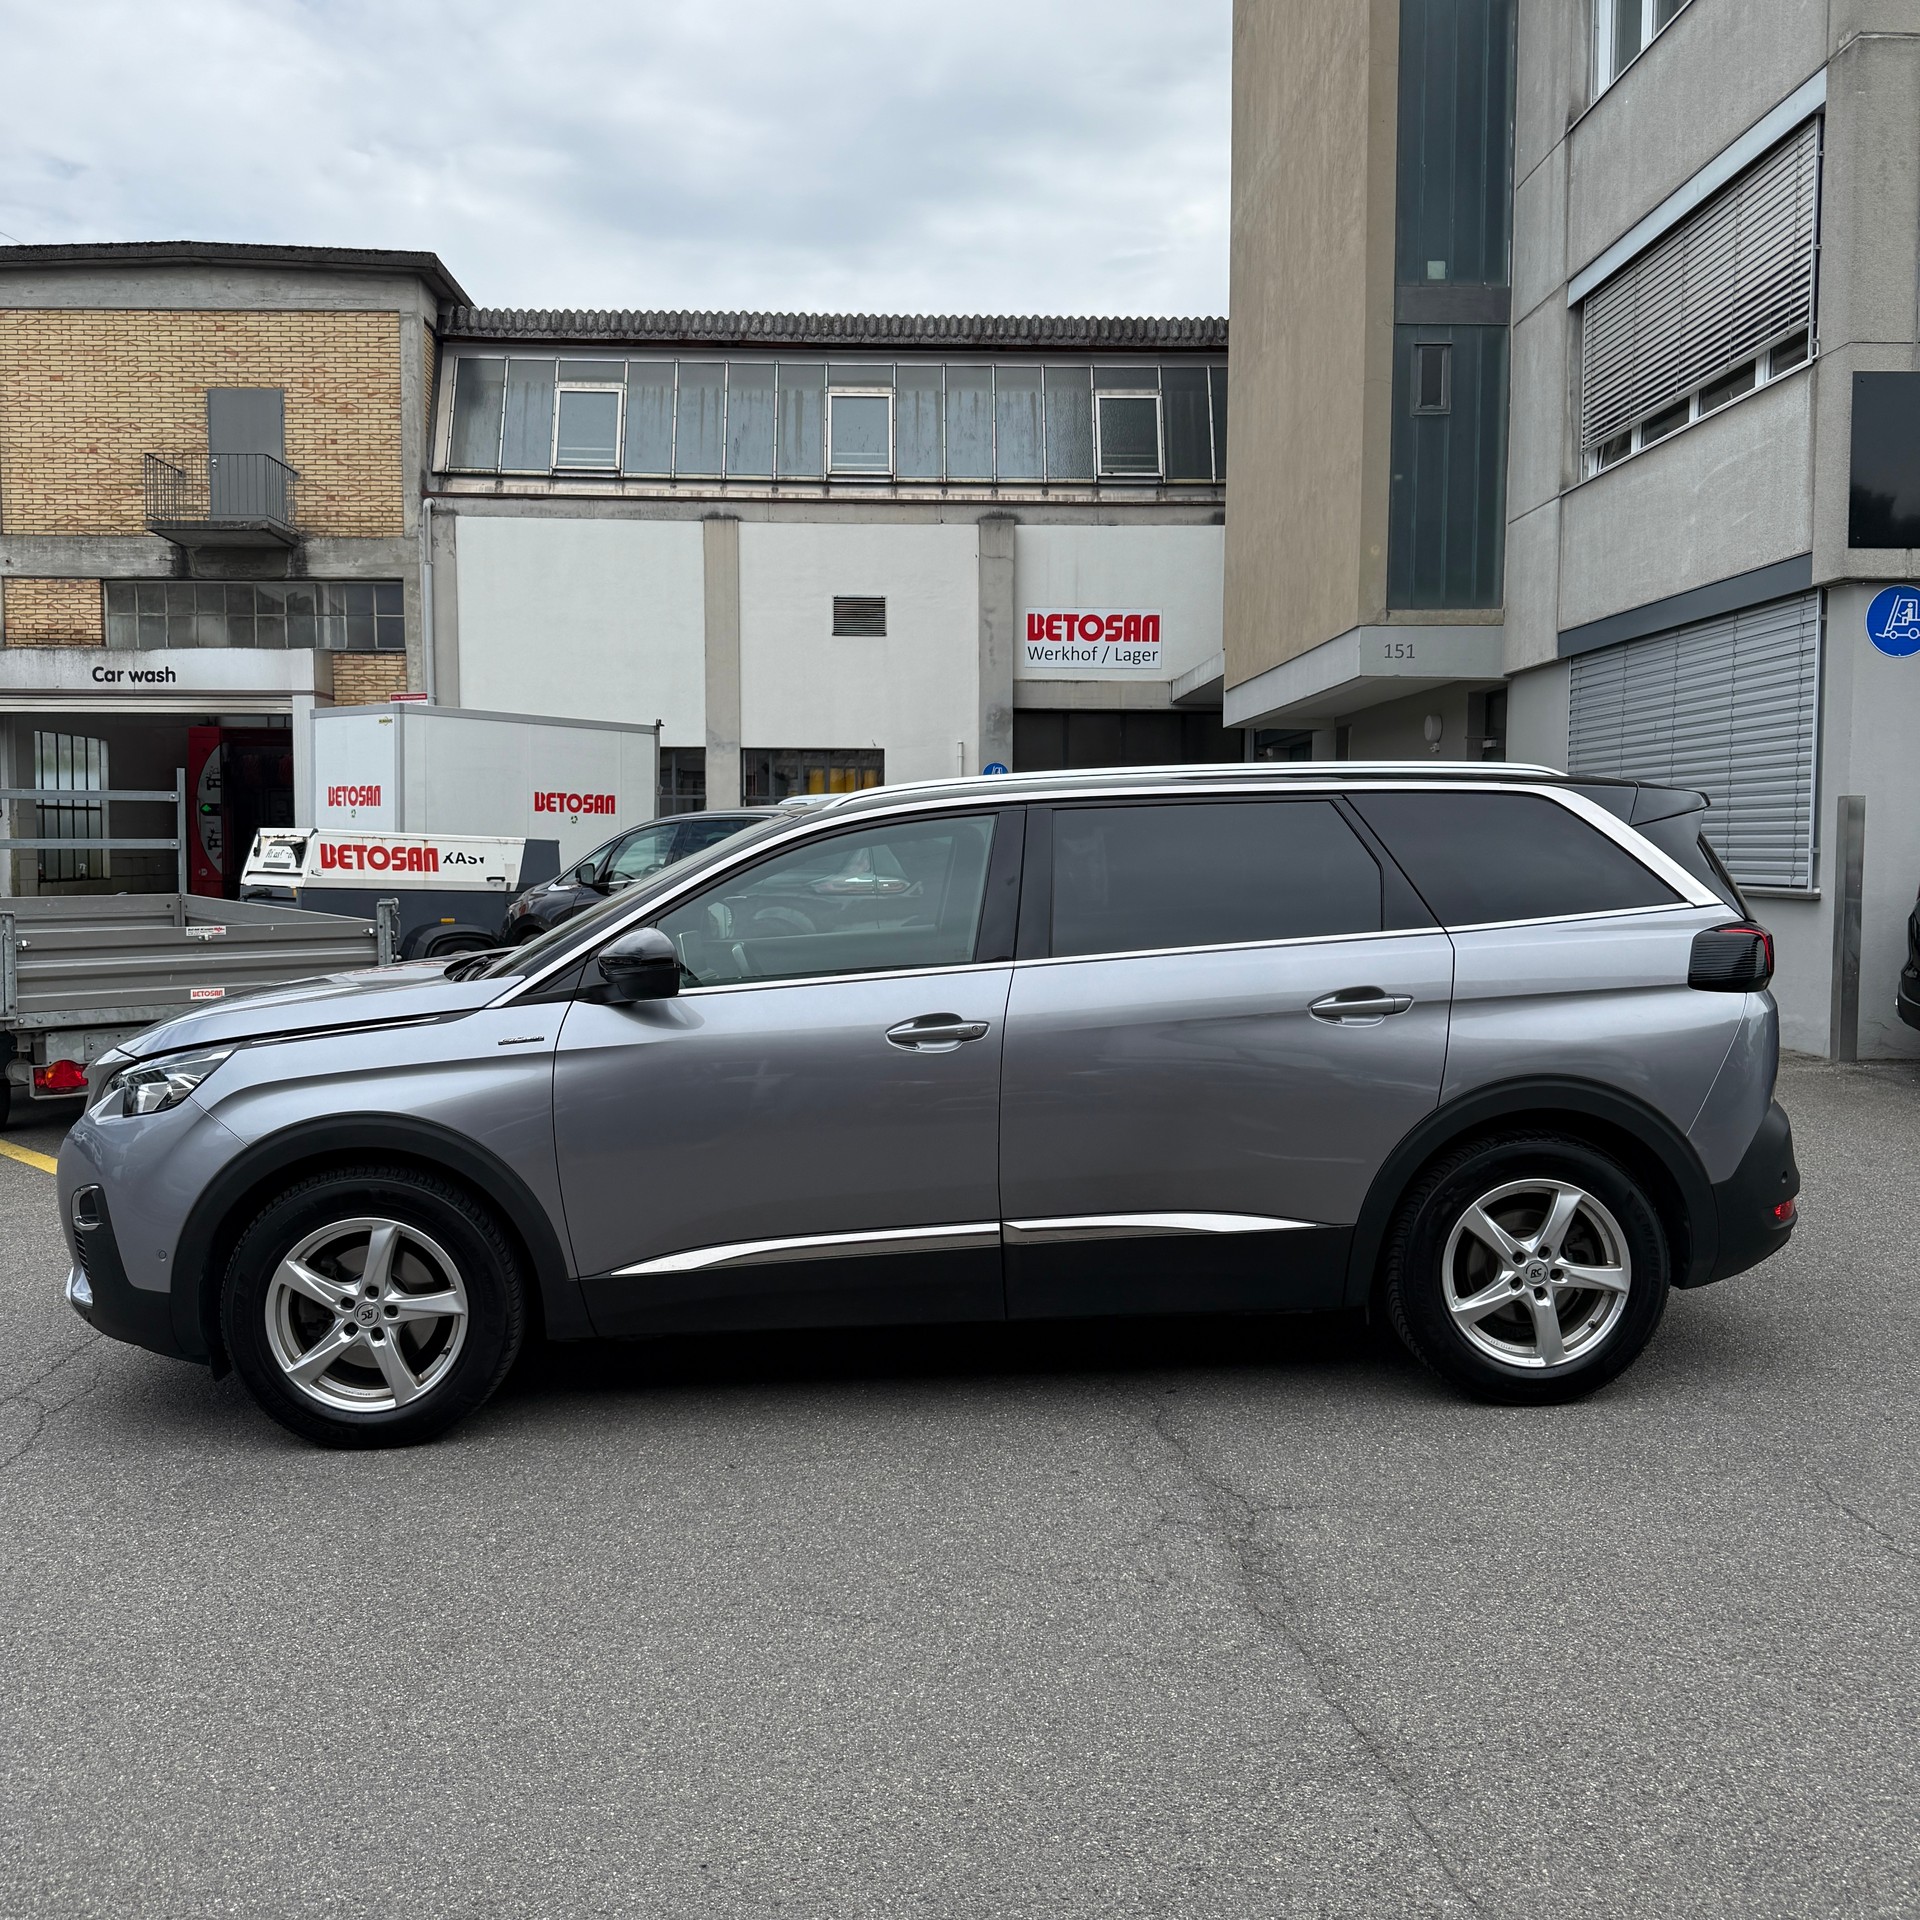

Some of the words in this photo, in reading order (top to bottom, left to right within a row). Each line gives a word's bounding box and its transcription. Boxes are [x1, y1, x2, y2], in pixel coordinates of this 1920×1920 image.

[1027, 613, 1160, 642] BETOSAN
[1027, 646, 1098, 661] Werkhof
[1101, 646, 1110, 664] /
[1115, 647, 1158, 665] Lager
[1384, 643, 1415, 659] 151
[92, 666, 124, 682] Car
[128, 666, 176, 682] wash
[327, 785, 381, 807] BETOSAN
[534, 791, 616, 814] BETOSAN
[320, 843, 440, 873] BETOSAN
